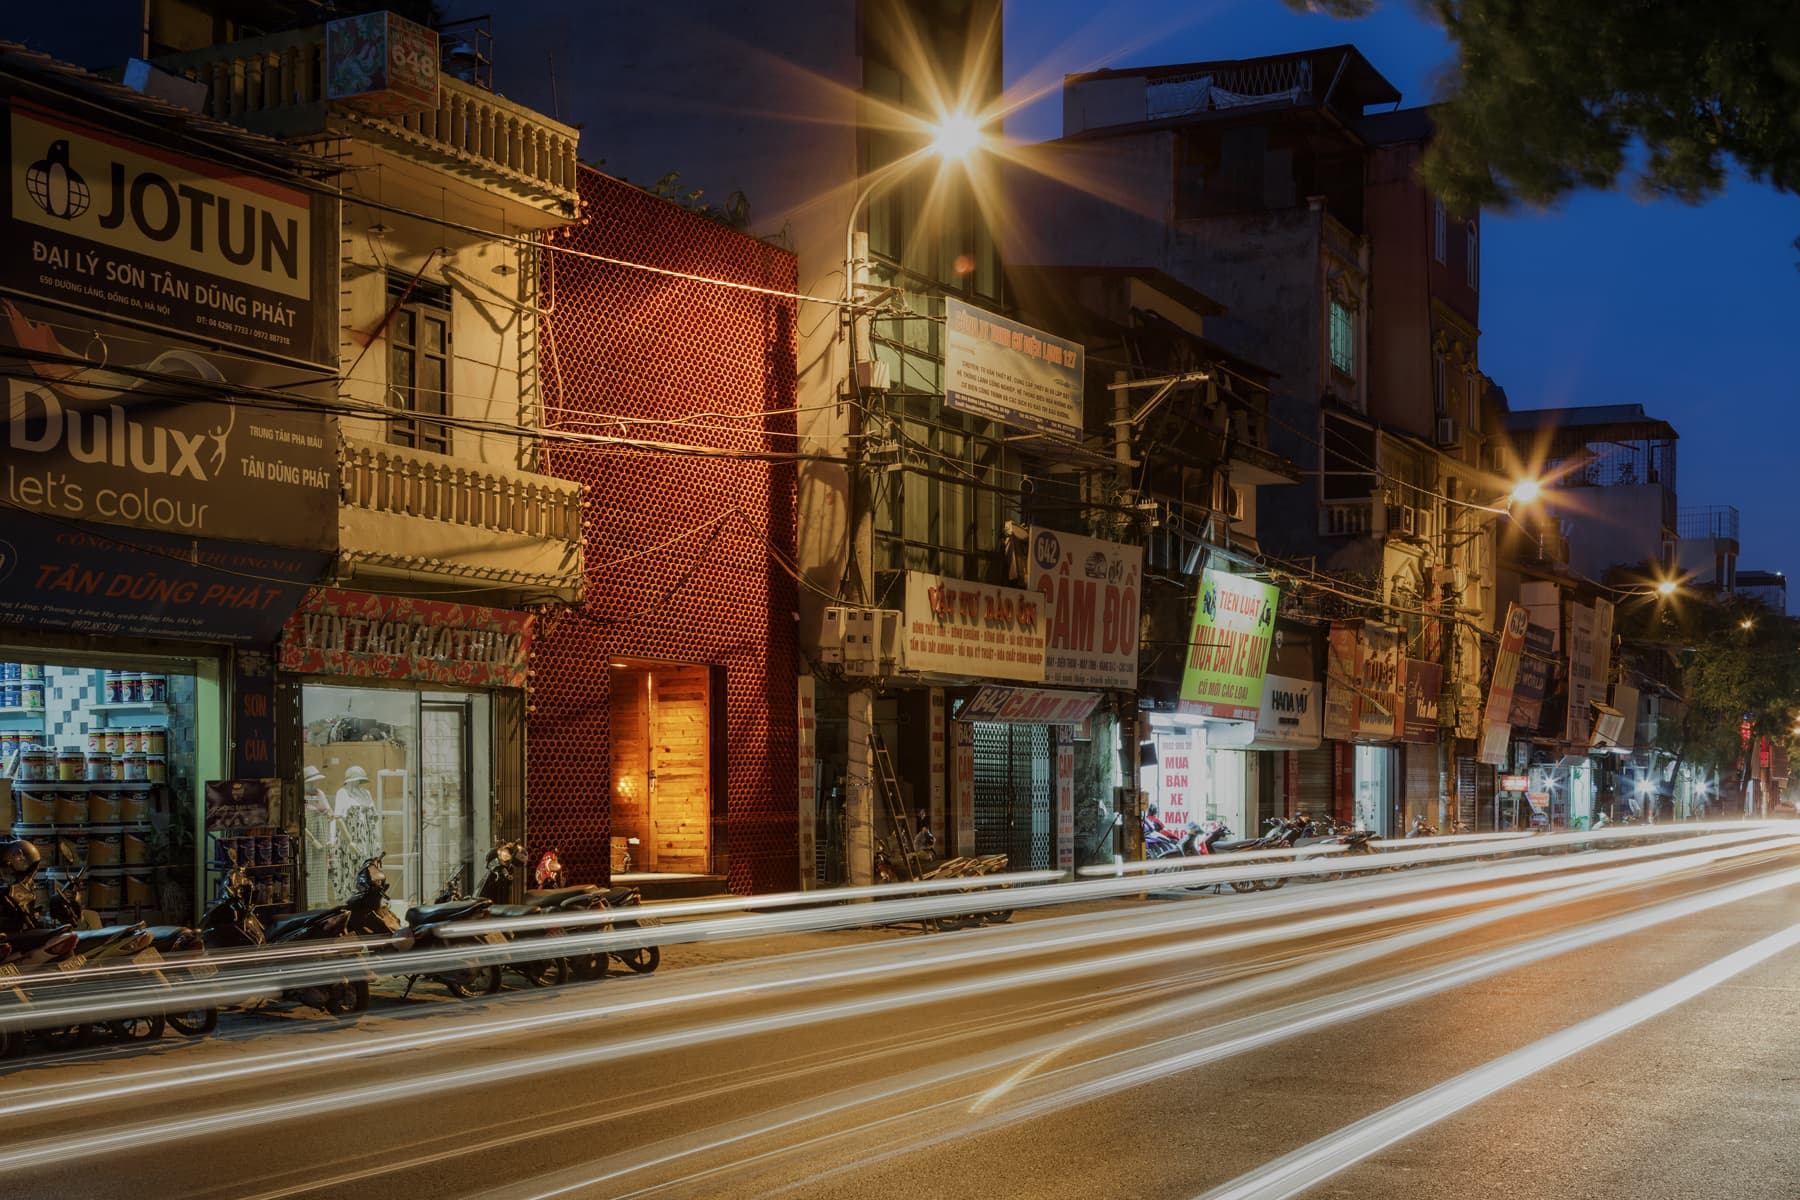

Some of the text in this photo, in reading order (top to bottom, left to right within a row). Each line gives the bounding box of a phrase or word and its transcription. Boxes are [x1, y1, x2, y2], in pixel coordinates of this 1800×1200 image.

[392, 45, 434, 78] 648
[98, 161, 298, 281] JOTUN
[33, 241, 297, 328] ĐẠI LÝ SƠN TÂN DŨNG PHÁT
[8, 378, 208, 482] Dulux
[249, 424, 273, 440] TRUNG
[275, 428, 290, 443] TÂM
[241, 455, 331, 489] TÂN DŨNG PHÁT
[8, 465, 209, 529] let's colour
[1036, 538, 1057, 564] 642
[34, 561, 285, 609] TÂN DŨNG PHÁT
[1037, 552, 1138, 657] CẦM ĐỒ
[303, 614, 521, 664] VINTAGE CLOTHING
[1511, 610, 1527, 635] 632
[1190, 624, 1217, 672] MUA
[1213, 620, 1234, 675] BÁN
[1232, 630, 1250, 676] XE
[1245, 627, 1269, 679] MÁY
[971, 688, 1011, 713] 642
[1058, 725, 1073, 744] 642
[1165, 756, 1189, 769] MUA
[1170, 793, 1184, 805] XE
